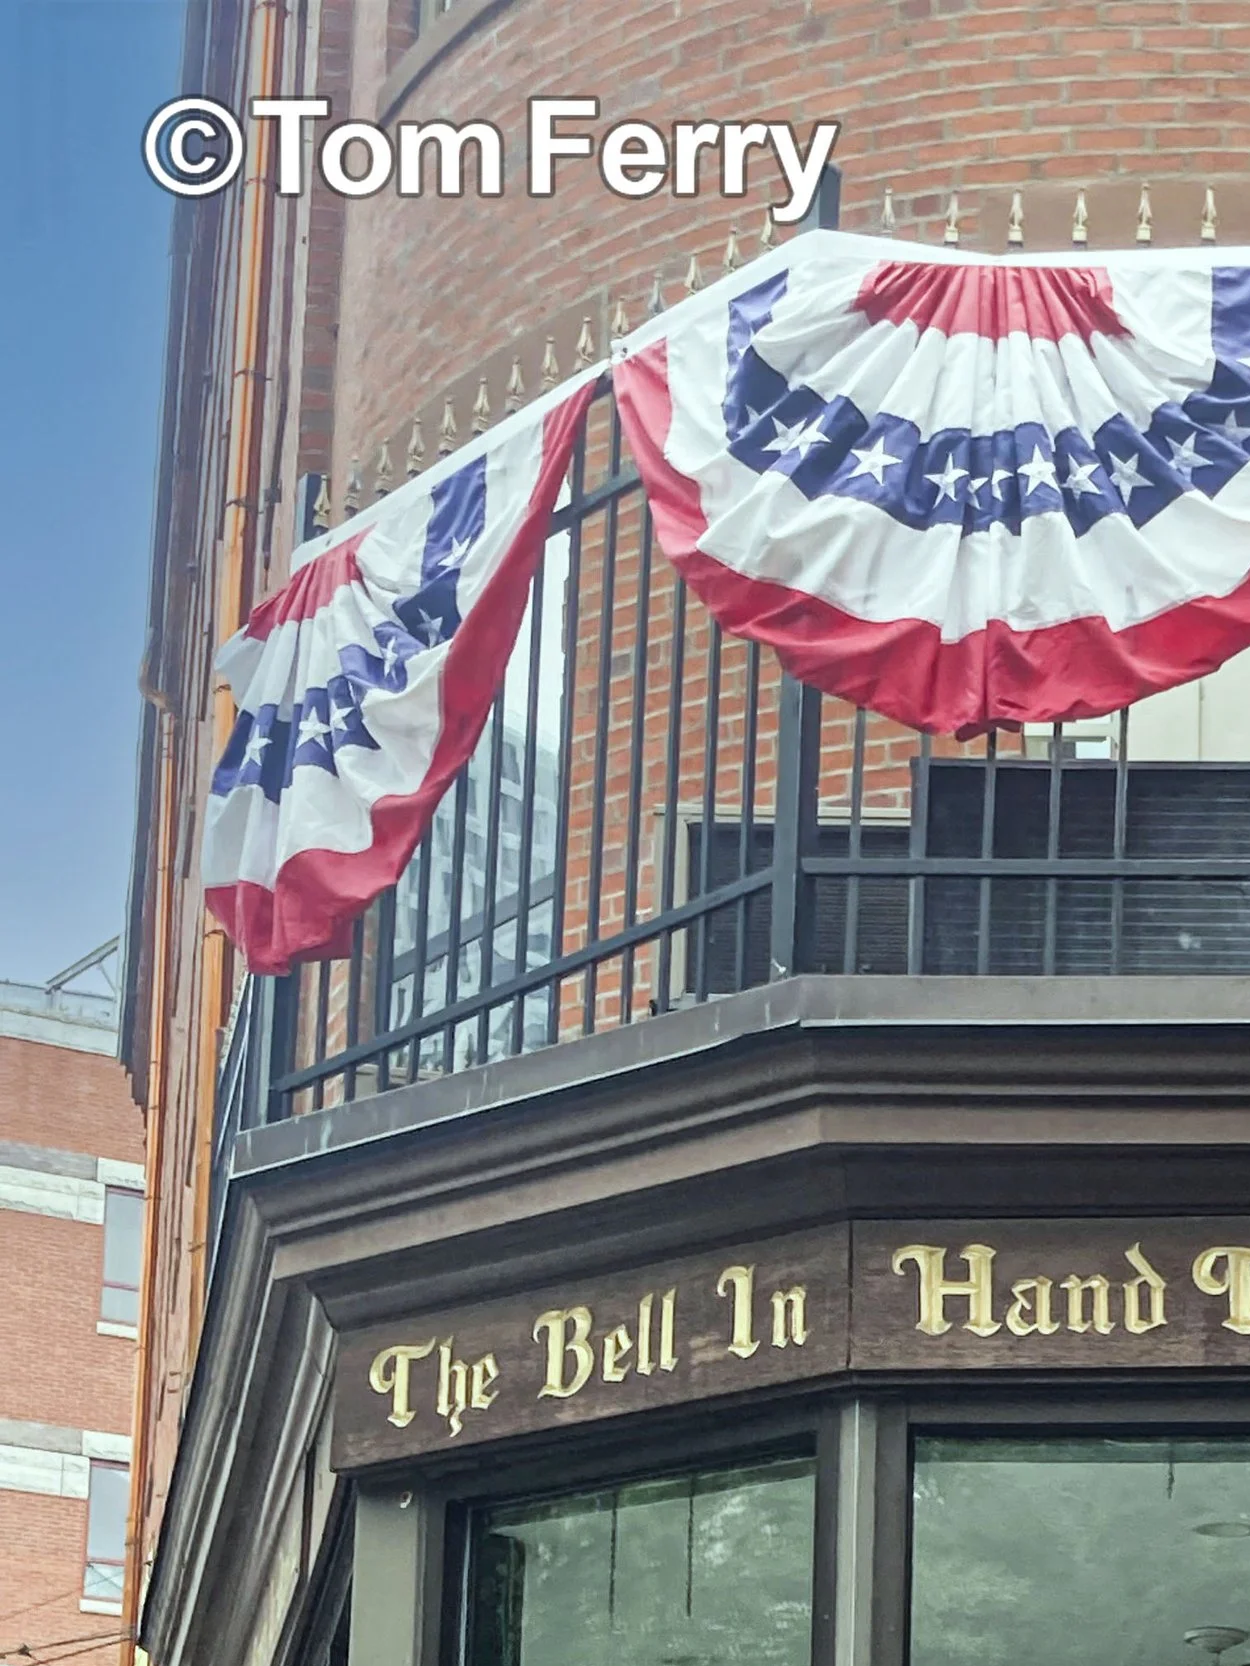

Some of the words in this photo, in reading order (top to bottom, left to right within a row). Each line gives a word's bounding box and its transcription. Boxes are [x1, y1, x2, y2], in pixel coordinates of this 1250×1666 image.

[368, 1334, 500, 1438] The
[531, 1287, 680, 1400] Bell
[716, 1263, 809, 1360] In
[891, 1241, 1169, 1337] Hand
